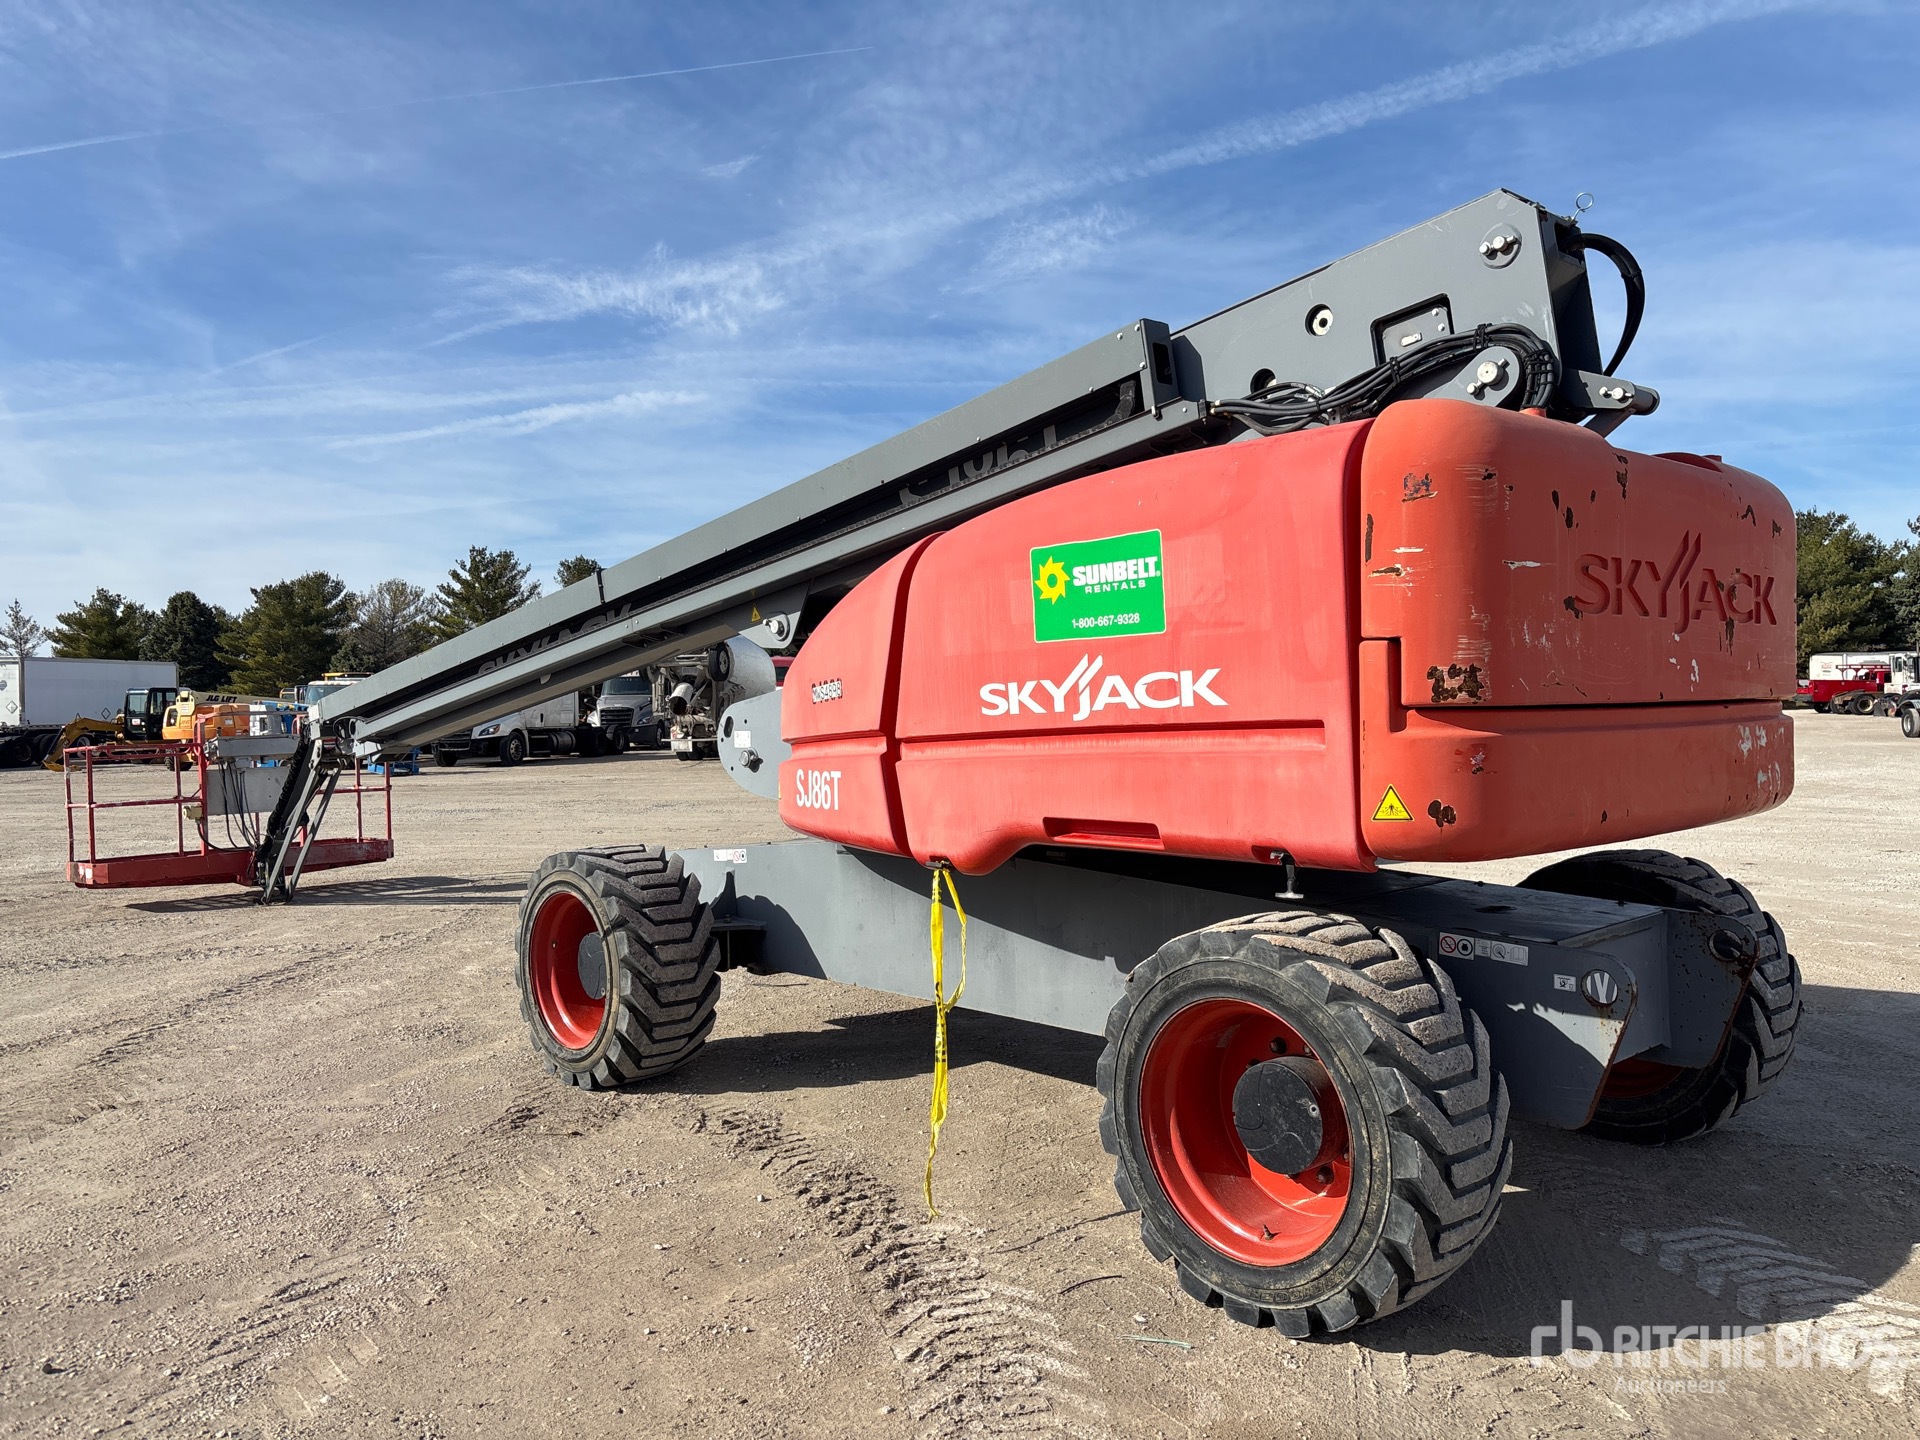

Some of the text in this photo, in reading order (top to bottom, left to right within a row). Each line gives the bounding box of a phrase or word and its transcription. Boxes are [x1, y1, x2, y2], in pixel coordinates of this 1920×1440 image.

[1072, 556, 1158, 587] SUNBELT
[1085, 580, 1146, 594] RENTALS
[1573, 529, 1777, 635] SKYJACK
[1072, 613, 1140, 629] 1-800-667-9328
[979, 653, 1229, 722] SKYJACK
[796, 768, 842, 811] SJ86T
